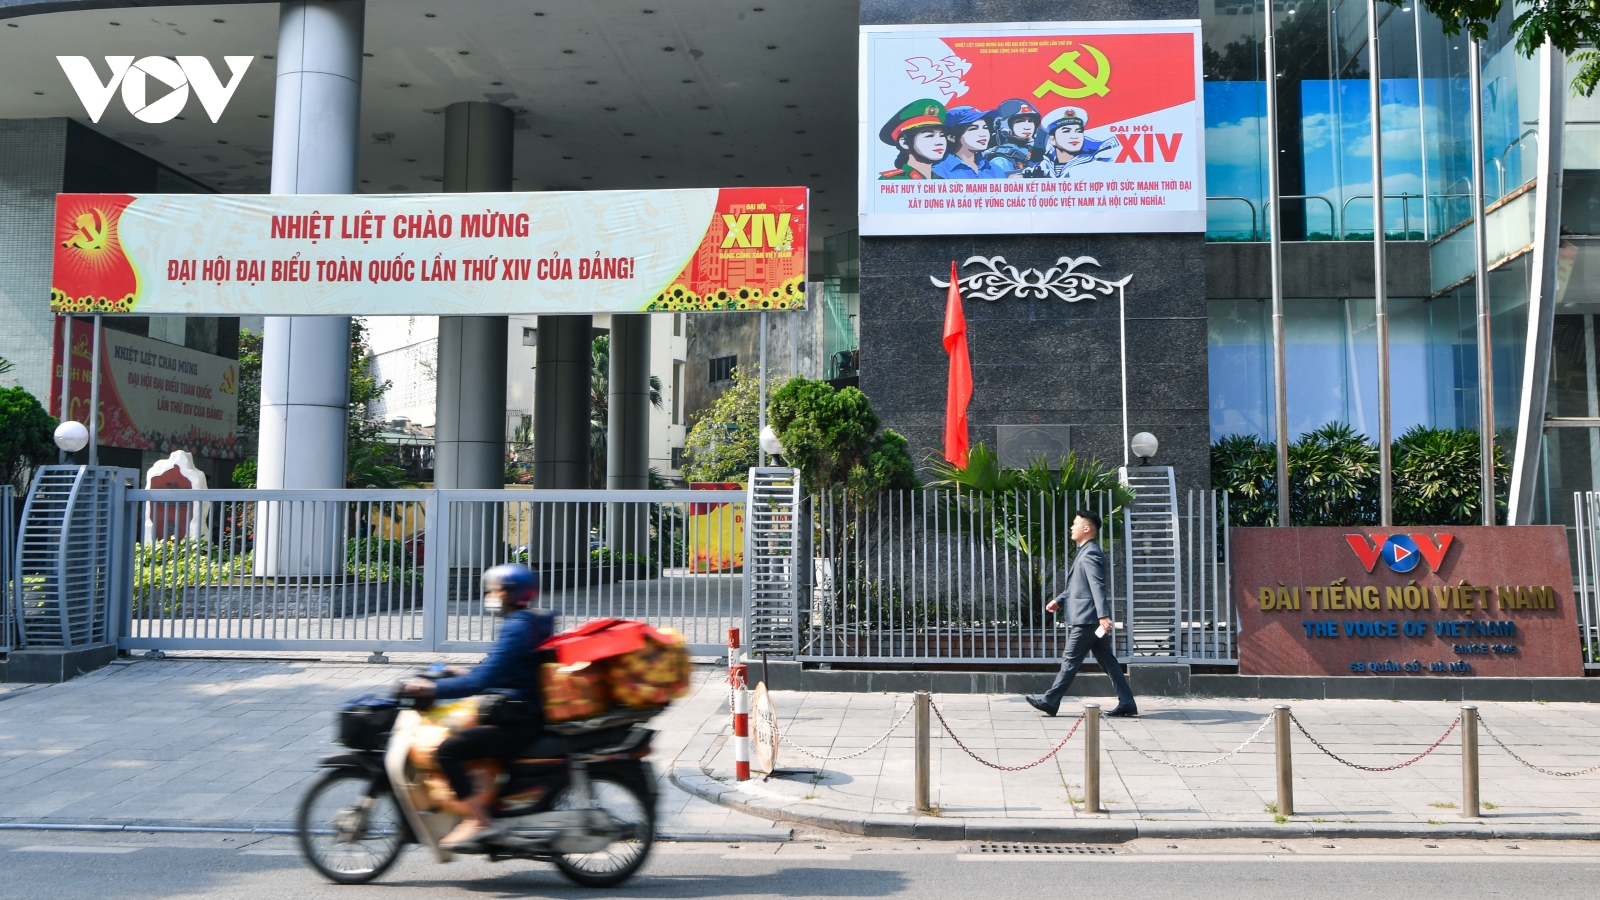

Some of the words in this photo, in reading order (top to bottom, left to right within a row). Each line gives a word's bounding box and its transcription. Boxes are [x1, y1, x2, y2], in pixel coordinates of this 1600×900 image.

[1133, 124, 1153, 134] HỘI
[1114, 133, 1183, 163] XIV
[880, 182, 899, 194] PHÁT
[901, 184, 915, 193] HUY
[917, 182, 922, 193] Ý
[923, 182, 935, 193] CHÍ
[937, 182, 947, 193] VÀ
[949, 181, 964, 193] SỨC
[965, 184, 988, 195] MẠNH
[989, 183, 1002, 195] ĐẠI
[1003, 181, 1024, 193] ĐOÀN
[1025, 180, 1039, 193] KẾT
[1041, 181, 1056, 192] DÂN
[1058, 181, 1072, 194] TỘC
[1074, 179, 1087, 192] KẾT
[1089, 181, 1104, 194] HỢP
[1106, 179, 1118, 191] VỚI
[1120, 179, 1135, 191] SỨC
[1137, 181, 1159, 193] MẠNH
[1161, 178, 1177, 191] THỜI
[1179, 181, 1192, 192] ĐẠI
[757, 202, 767, 211] HỘI
[908, 197, 922, 209] XÂY
[924, 198, 944, 210] DỰNG
[946, 197, 955, 208] VÀ
[957, 195, 972, 208] BẢO
[974, 197, 983, 210] VỆ
[984, 197, 1004, 208] VỮNG
[1006, 195, 1025, 208] CHẮC
[1028, 194, 1037, 208] TỔ
[1039, 194, 1059, 208] QUỐC
[1060, 195, 1076, 209] VIỆT
[1077, 197, 1095, 207] NAM
[1097, 195, 1107, 206] XÃ
[1109, 194, 1121, 209] HỘI
[1123, 192, 1138, 206] CHỦ
[1140, 194, 1166, 206] NGHĨA!
[270, 210, 334, 244] NHIỆT
[341, 210, 386, 244] LIỆT
[393, 209, 452, 239] CHÀO
[460, 209, 529, 238] MỪNG
[720, 213, 792, 249] XIV
[167, 259, 197, 286] ĐẠI
[202, 255, 231, 286] HỘI
[236, 260, 266, 286] ĐẠI
[271, 252, 311, 282] BIỂU
[316, 256, 363, 282] TOÀN
[368, 252, 415, 284] QUỐC
[421, 252, 456, 281] LẦN
[462, 254, 498, 281] THỨ
[501, 259, 531, 280] XIV
[537, 251, 573, 280] CỦA
[579, 250, 635, 280] ĐẢNG!
[1344, 533, 1455, 573] VOV
[1258, 580, 1300, 610] ĐÀI
[1305, 576, 1381, 610] TIẾNG
[1386, 579, 1430, 610] NÓI
[1434, 579, 1490, 616] VIỆT
[1496, 585, 1555, 609] NAM
[1303, 621, 1338, 637] THE
[1343, 621, 1399, 637] VOICE
[1403, 621, 1427, 637] OF
[1432, 621, 1515, 637] VIETNAM
[1452, 643, 1489, 654] SINCE
[1491, 643, 1516, 654] 1945
[1349, 662, 1365, 672] 58
[1430, 659, 1447, 672] HÀ
[1449, 659, 1471, 674] NỘI
